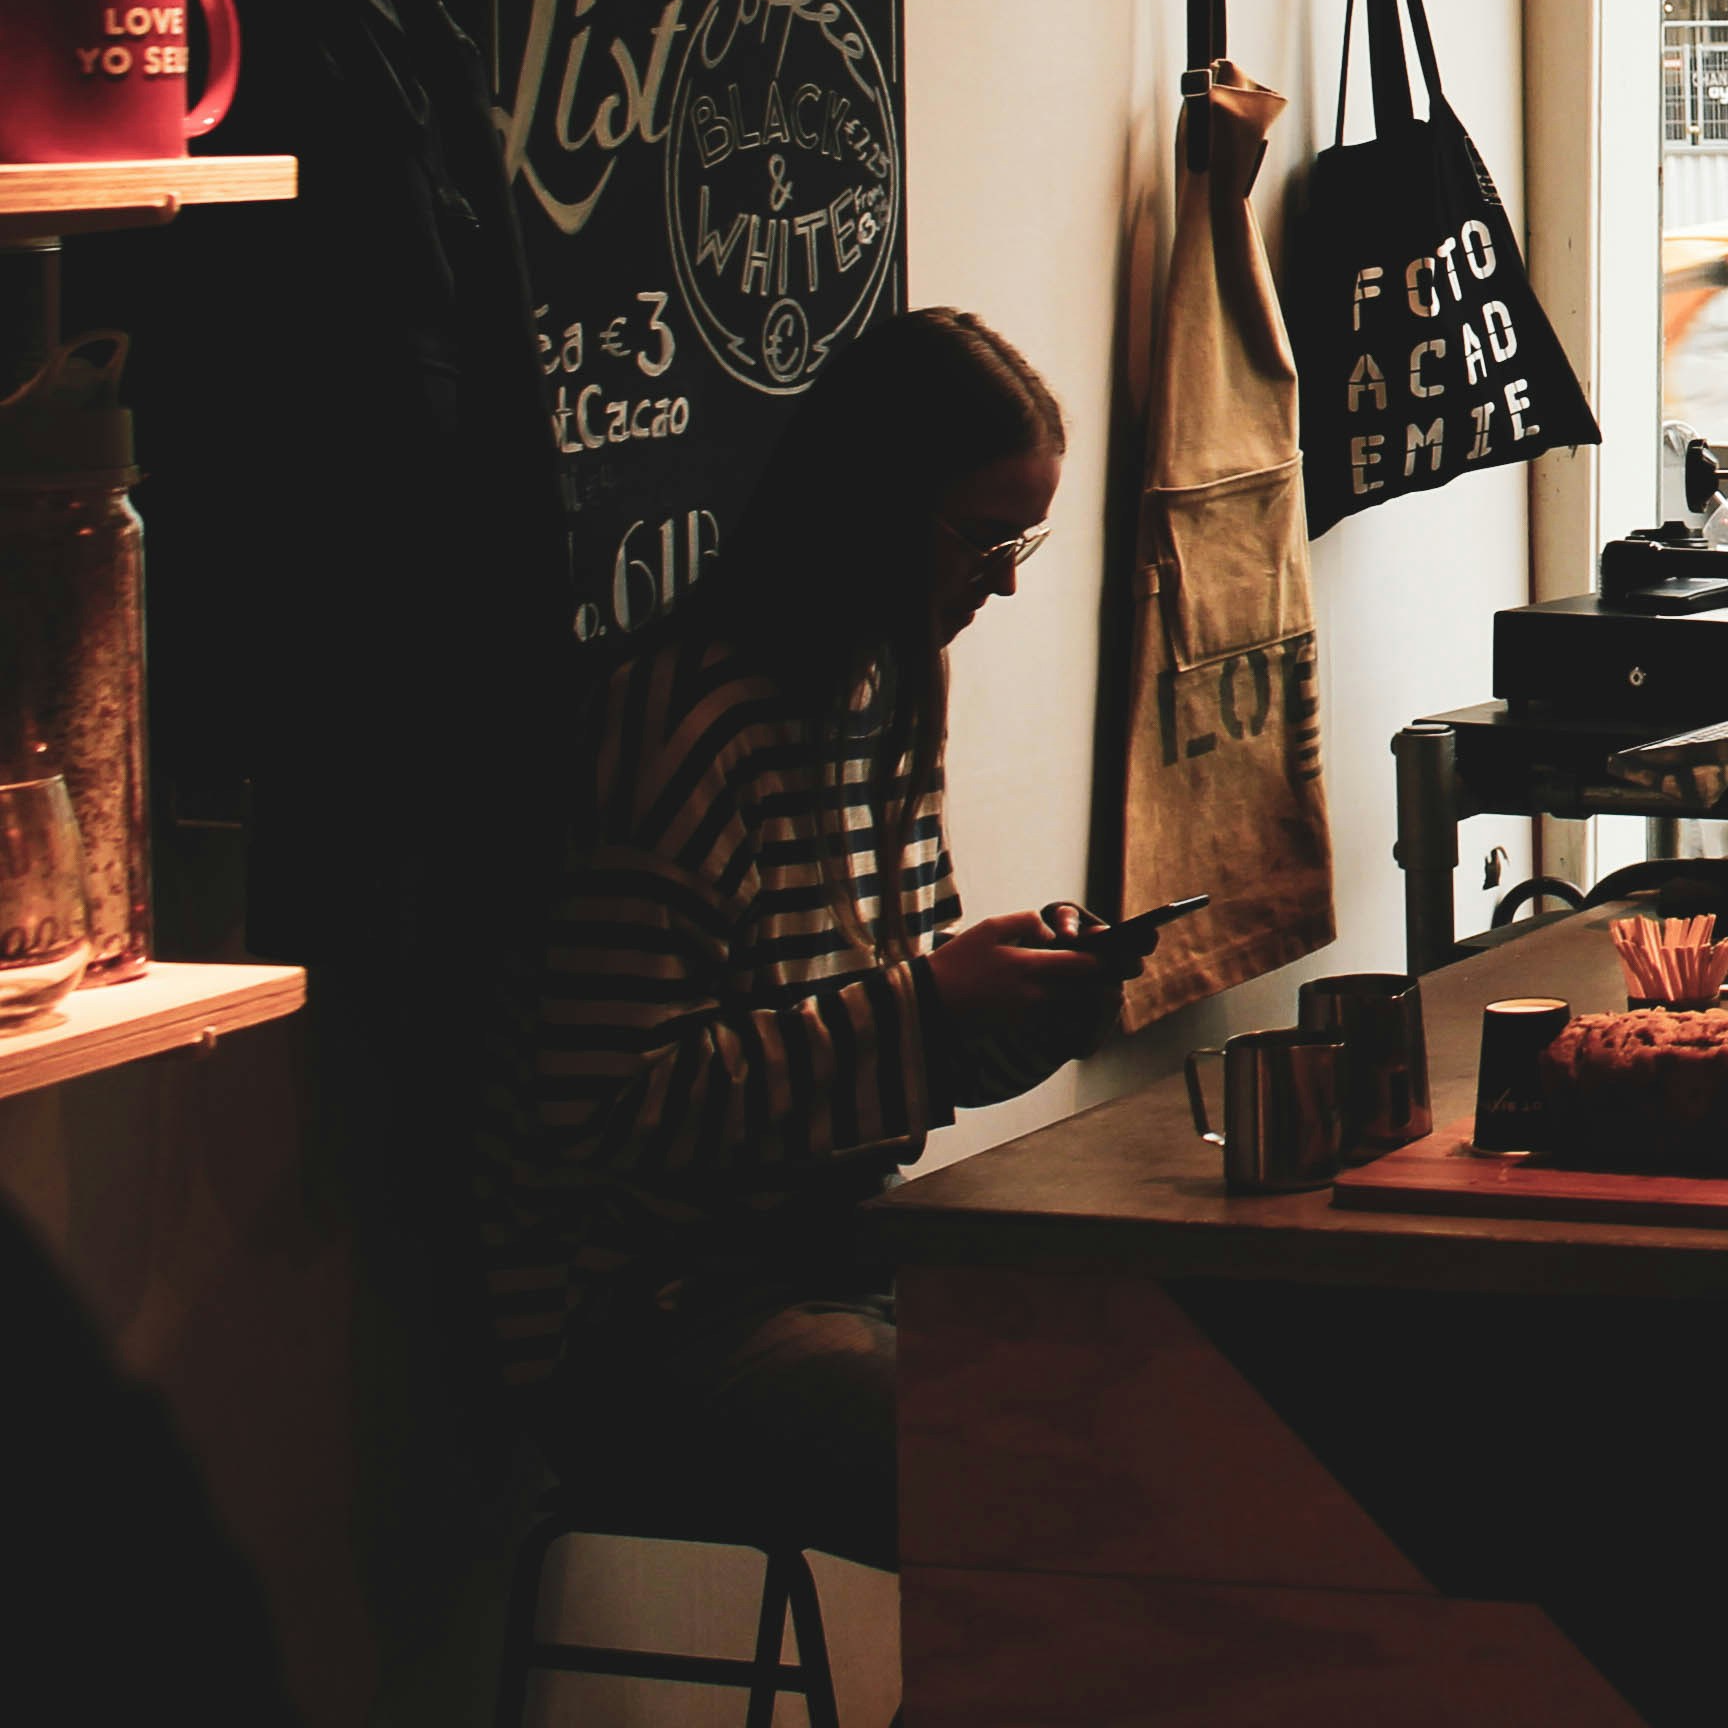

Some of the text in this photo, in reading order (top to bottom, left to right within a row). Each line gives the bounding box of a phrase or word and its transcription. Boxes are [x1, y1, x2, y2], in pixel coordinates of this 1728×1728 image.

[76, 46, 133, 75] YO
[104, 6, 184, 36] LOVE
[690, 80, 852, 168] BLACK
[769, 154, 793, 211] &
[696, 186, 862, 296] WHITE
[1353, 218, 1500, 332] FOTO
[1347, 298, 1520, 413] ACAD
[577, 384, 689, 448] Cacao
[1349, 378, 1542, 496] EMIE
